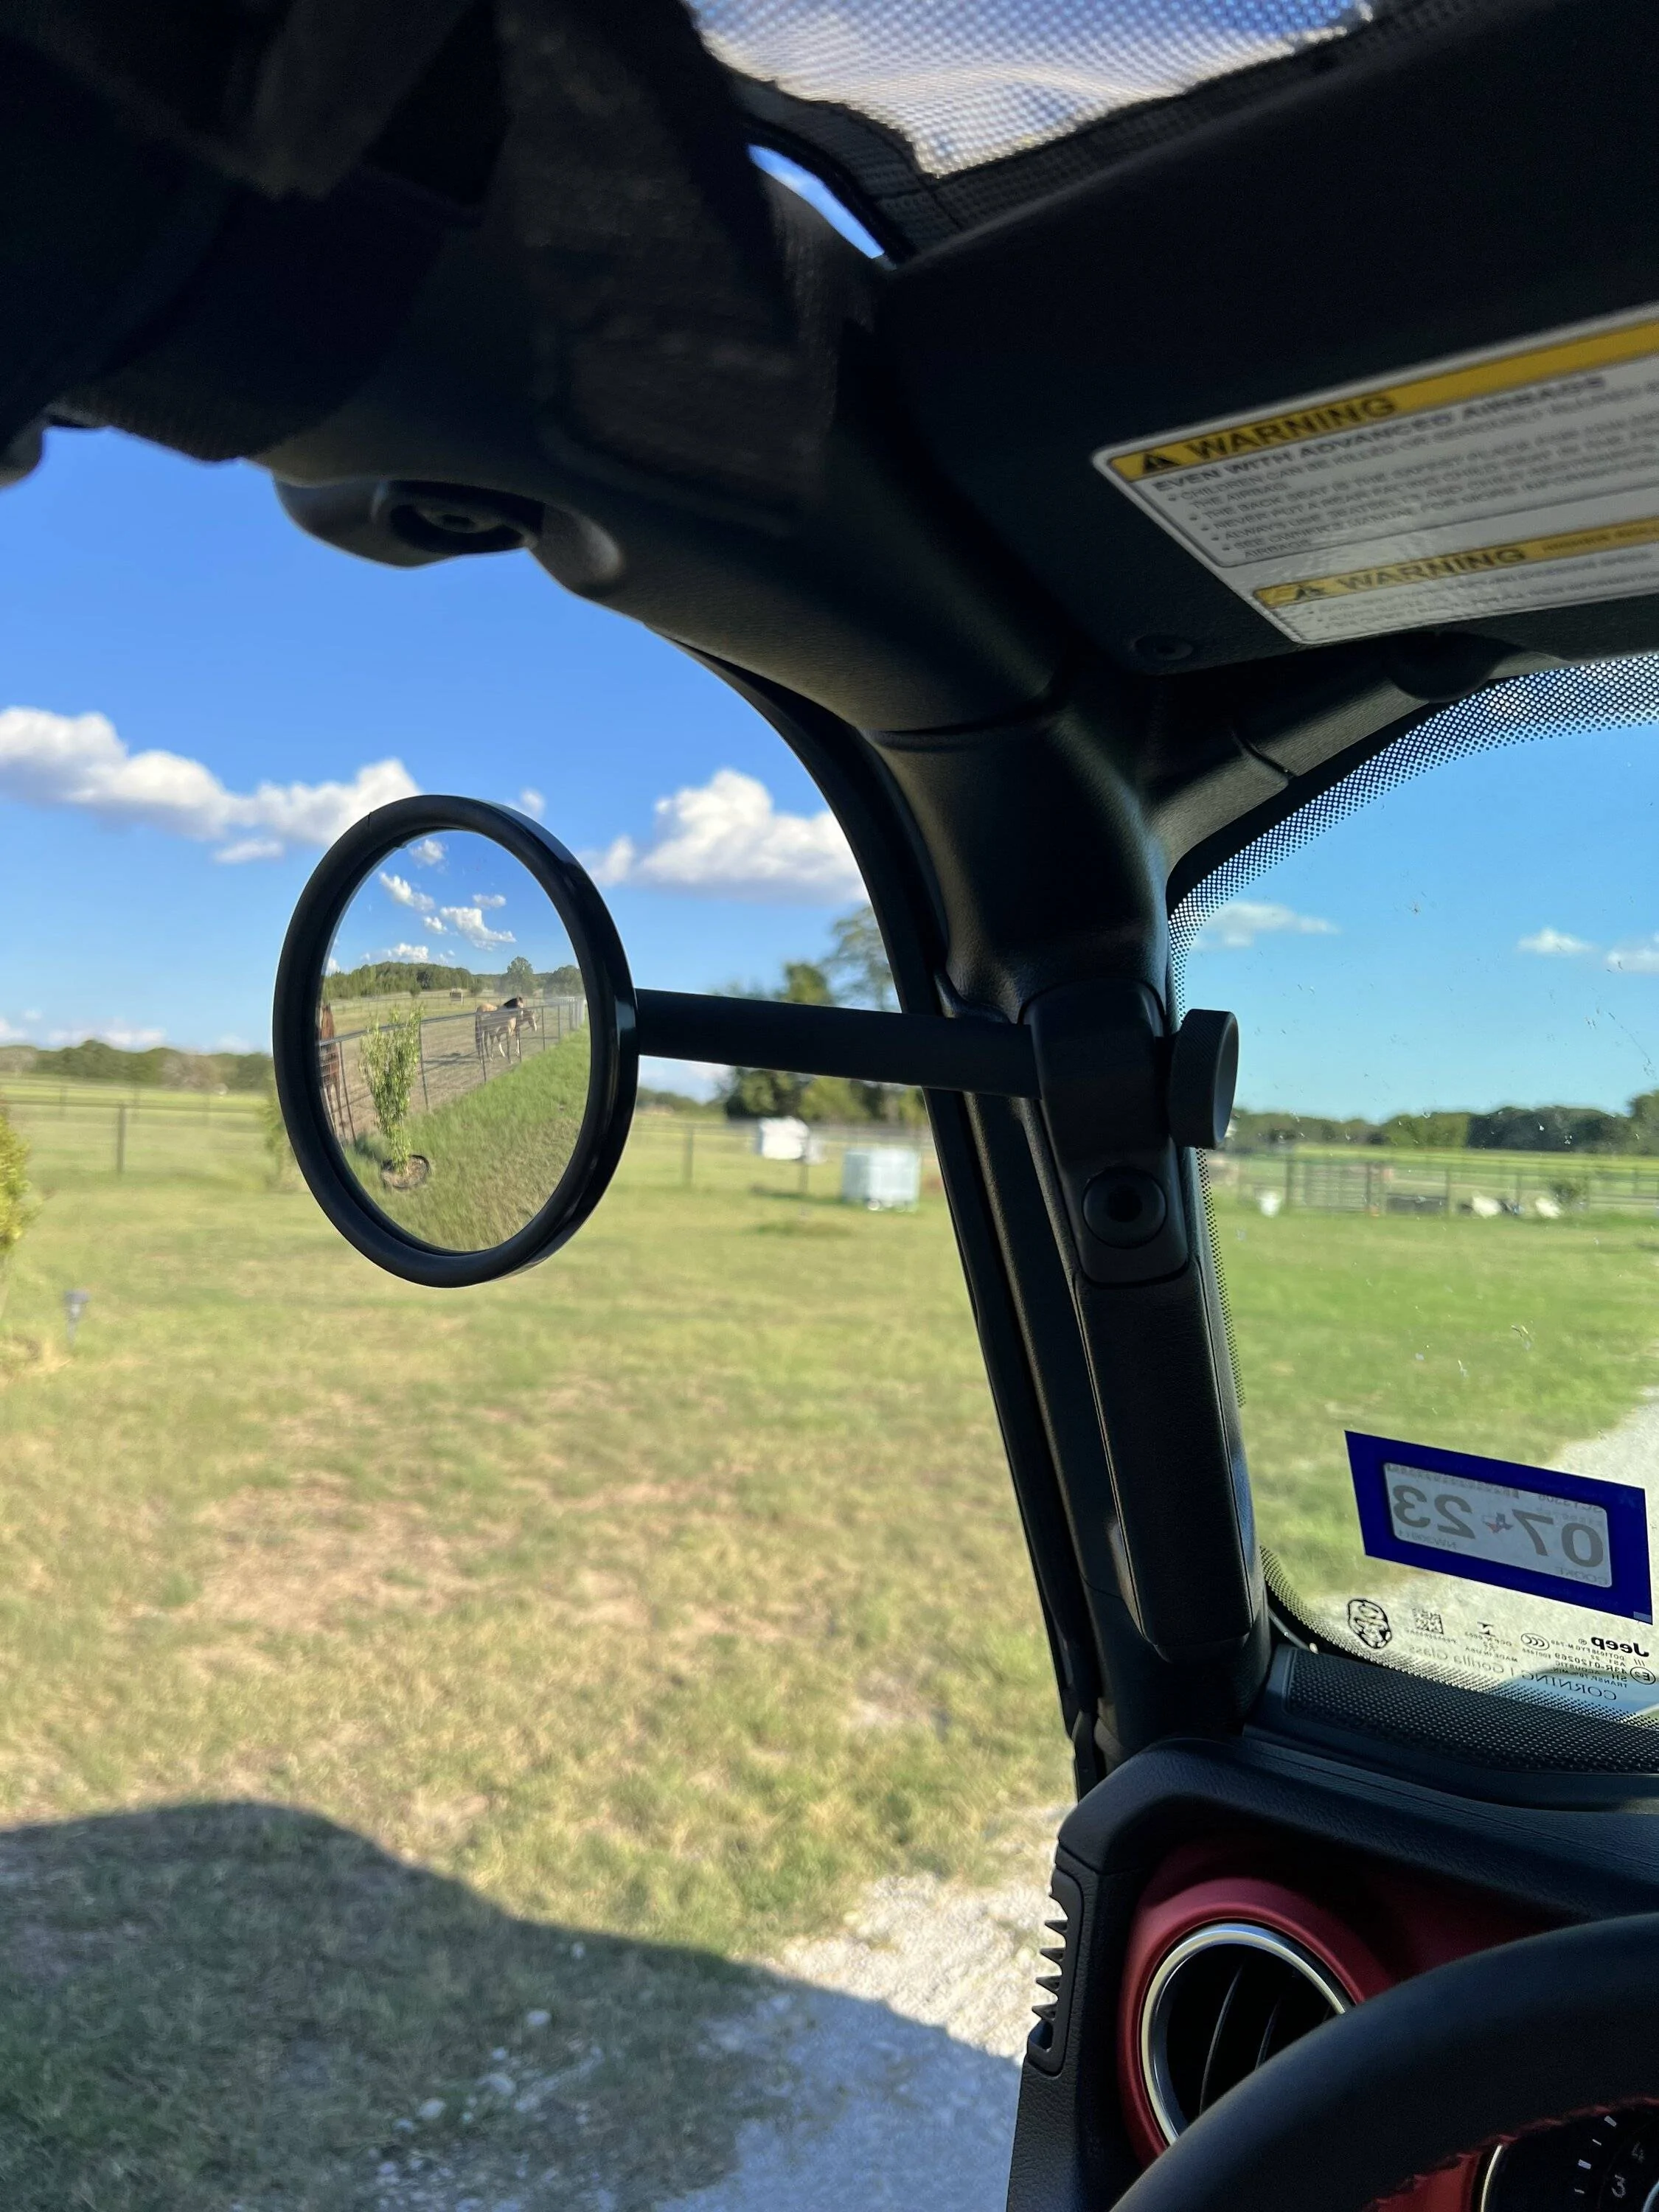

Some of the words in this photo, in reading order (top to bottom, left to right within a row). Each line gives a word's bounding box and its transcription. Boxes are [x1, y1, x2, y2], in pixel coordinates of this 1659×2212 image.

[1184, 395, 1396, 460] WARNING
[1152, 468, 1222, 493] EVEN
[1223, 451, 1293, 475] WITH
[1300, 411, 1453, 459] ADVANCED
[1180, 476, 1265, 501] CHILDREN
[1266, 464, 1303, 481] CAN
[1338, 547, 1526, 591] WARNING
[1631, 2140, 1645, 2164] 4
[1611, 2174, 1627, 2199] 3
